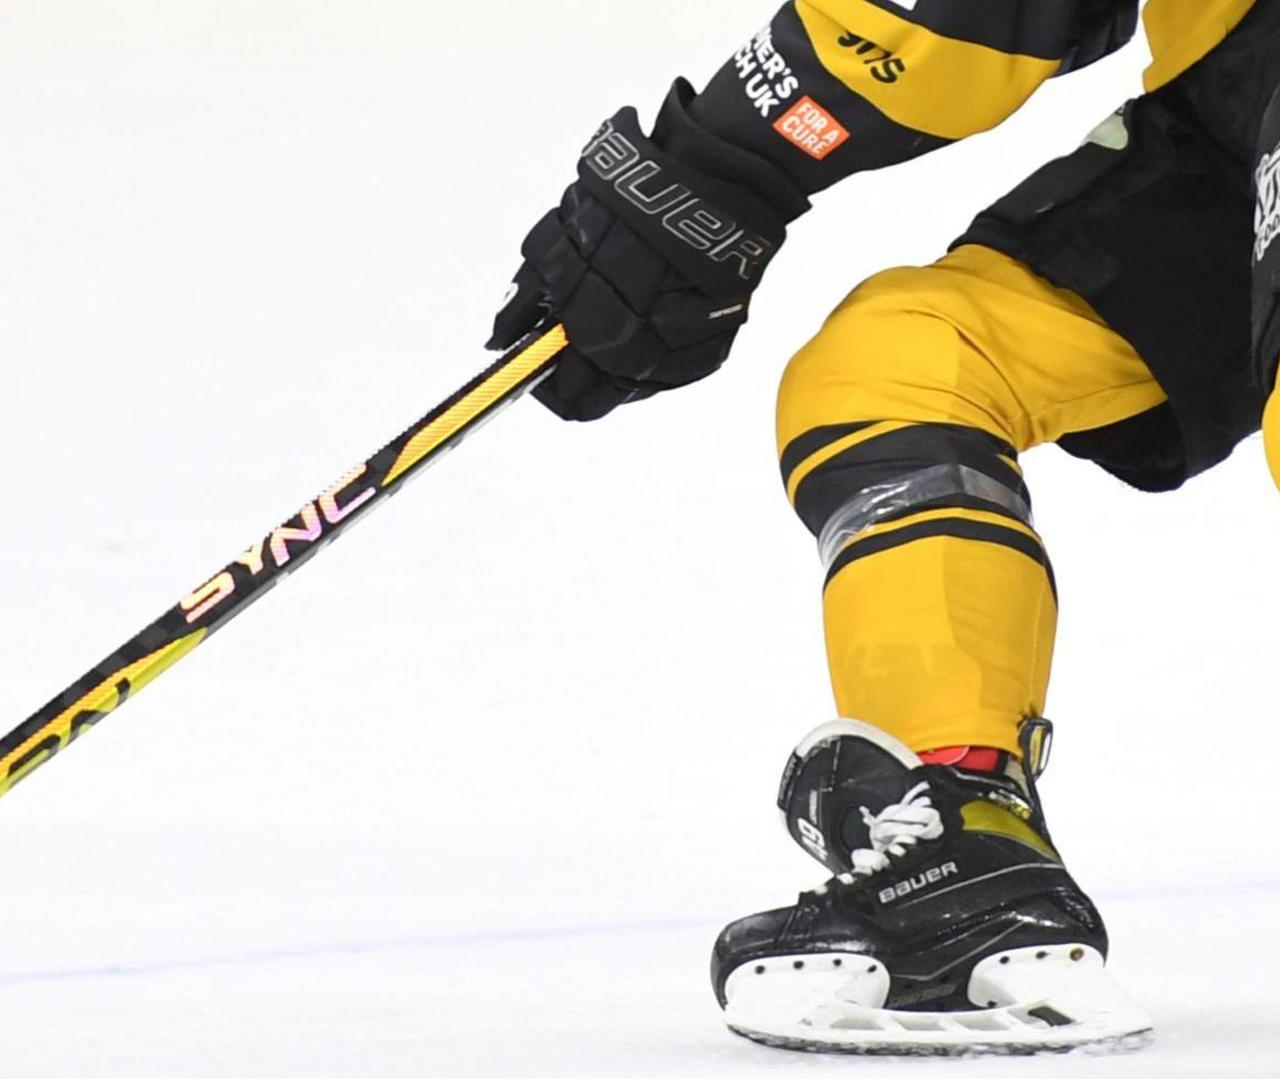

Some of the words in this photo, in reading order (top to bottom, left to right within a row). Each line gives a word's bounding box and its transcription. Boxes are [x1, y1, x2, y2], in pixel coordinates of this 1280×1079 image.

[745, 72, 780, 118] UK
[782, 115, 830, 156] CURE
[796, 102, 829, 134] FOR
[180, 463, 377, 623] SYNC
[878, 861, 959, 905] BAUER
